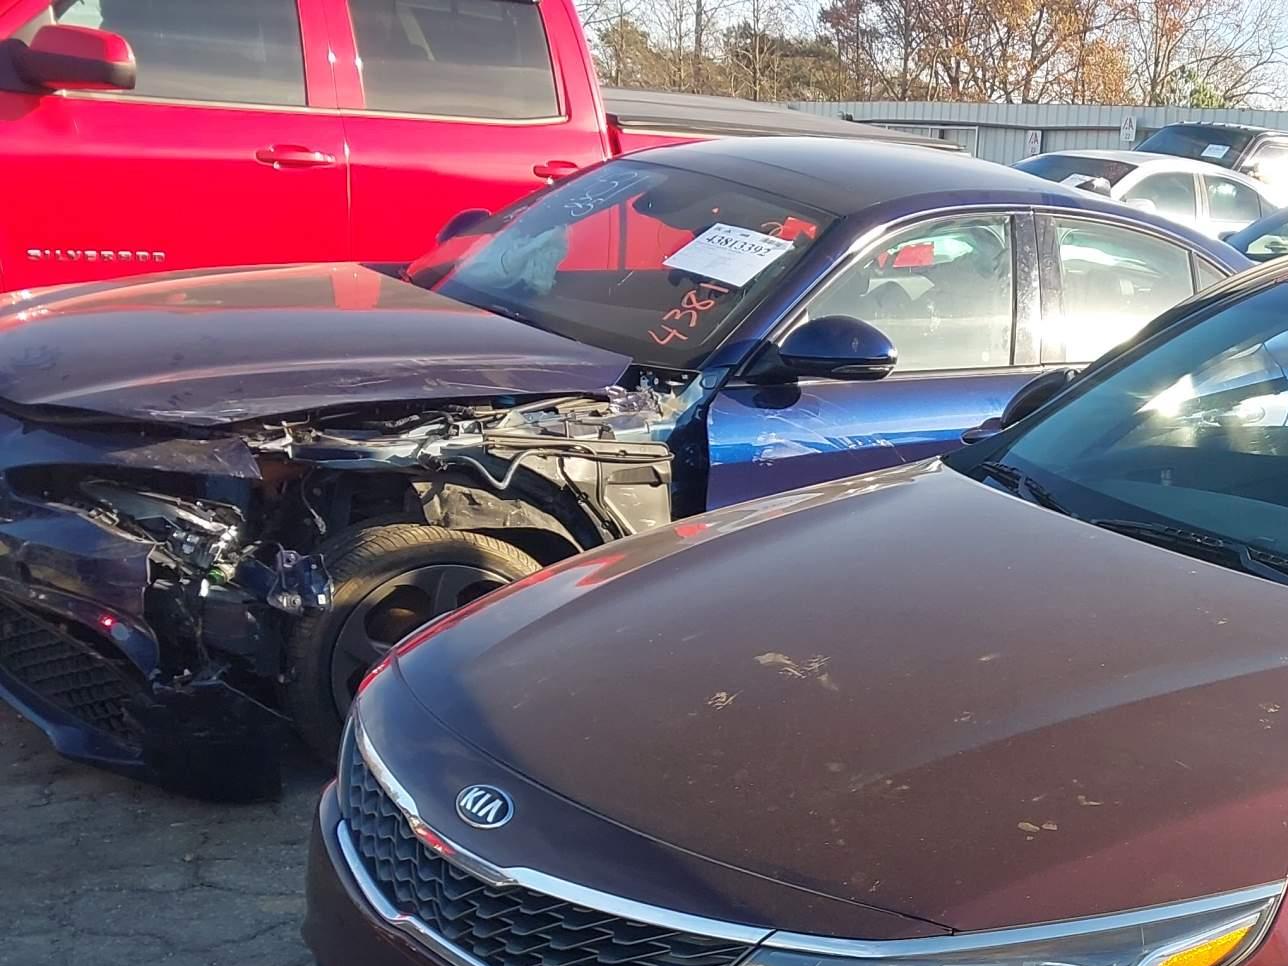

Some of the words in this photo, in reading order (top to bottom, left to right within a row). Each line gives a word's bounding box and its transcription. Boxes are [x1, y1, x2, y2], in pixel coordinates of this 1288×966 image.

[26, 249, 166, 262] SILVERADO
[705, 234, 772, 257] 43813392
[459, 787, 504, 823] KIA
